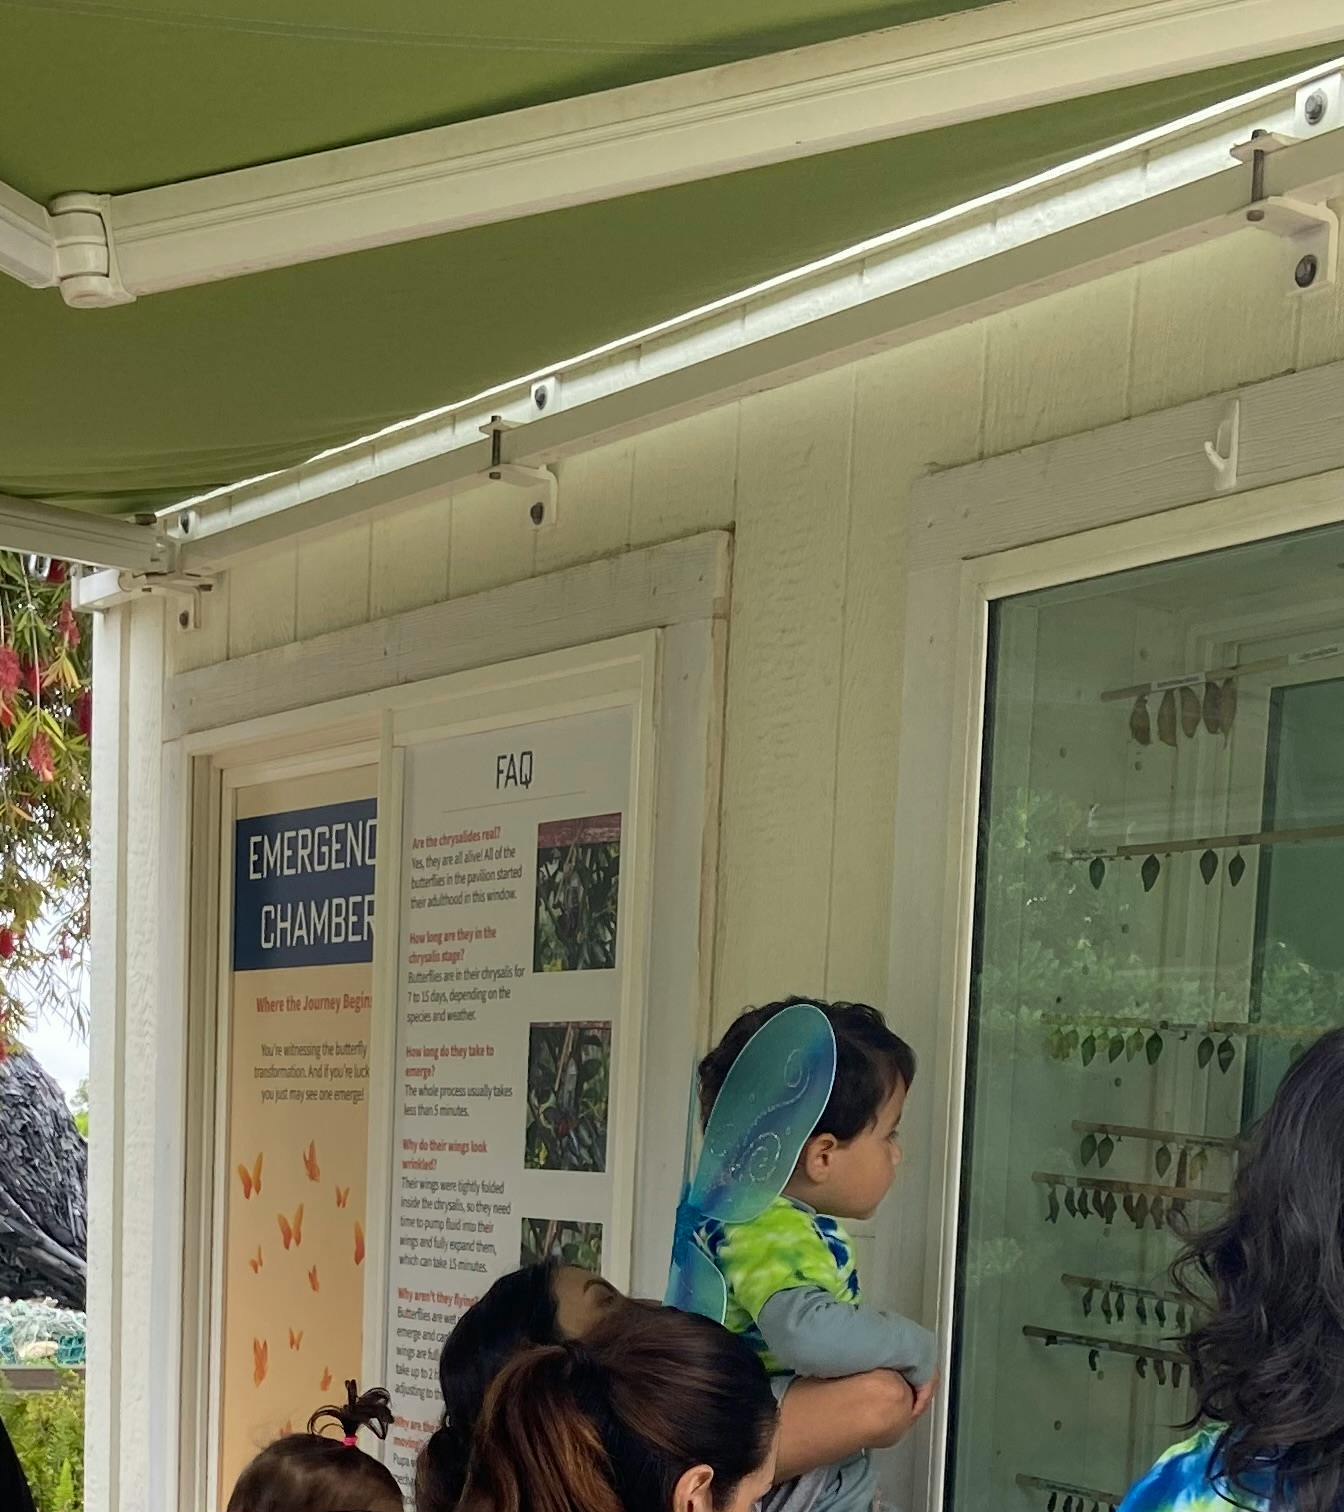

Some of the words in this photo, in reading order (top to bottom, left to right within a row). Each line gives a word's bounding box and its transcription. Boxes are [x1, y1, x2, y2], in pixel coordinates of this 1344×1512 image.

[497, 751, 533, 789] FAQ
[413, 837, 425, 849] Are
[426, 835, 438, 847] the
[439, 830, 481, 848] chrysalides
[482, 826, 501, 841] real?
[412, 857, 424, 869] Yes,
[426, 855, 441, 870] they
[442, 856, 453, 866] are
[455, 852, 463, 864] all
[464, 850, 483, 863] alive!
[484, 848, 494, 861] All
[495, 847, 503, 860] of
[504, 847, 516, 859] the
[411, 874, 445, 890] butterflies
[446, 875, 453, 886] in
[454, 874, 466, 885] the
[467, 869, 496, 887] pavilion
[497, 866, 523, 880] started
[411, 896, 427, 909] their
[427, 892, 463, 908] adulthood
[464, 892, 472, 904] in
[472, 890, 485, 903] this
[487, 888, 517, 901] window.
[261, 895, 375, 949] CHAMBER
[410, 932, 425, 944] How
[427, 931, 443, 946] long
[444, 933, 455, 941] are
[457, 928, 474, 943] they
[475, 927, 482, 940] in
[484, 926, 496, 939] the
[408, 950, 440, 966] chrysalis
[442, 948, 464, 965] stage?
[408, 970, 442, 984] Butterflies
[444, 972, 454, 982] are
[456, 969, 463, 981] in
[464, 968, 480, 981] their
[481, 966, 513, 982] chrysalis
[515, 964, 526, 978] for
[408, 992, 412, 1002] 7
[413, 992, 421, 1003] to
[422, 991, 430, 1003] 15
[450, 987, 487, 1004] depending
[488, 990, 498, 1000] on
[499, 986, 511, 999] the
[257, 996, 284, 1012] Where
[287, 996, 301, 1011] the
[304, 996, 341, 1013] Journey
[407, 1011, 432, 1024] species
[433, 1010, 446, 1022] and
[447, 1009, 476, 1021] weather.
[262, 1044, 282, 1056] You're
[284, 1042, 321, 1059] witnessing
[323, 1042, 334, 1056] the
[336, 1040, 367, 1059] butterfly
[406, 1047, 422, 1058] How
[423, 1045, 439, 1061] long
[440, 1045, 449, 1056] do
[451, 1045, 467, 1059] they
[469, 1044, 485, 1056] take
[486, 1045, 495, 1056] to
[255, 1065, 307, 1078] transformation.
[309, 1065, 323, 1078] And
[324, 1064, 329, 1078] if
[330, 1065, 352, 1080] you're
[406, 1065, 436, 1080] emerge?
[261, 1090, 274, 1103] you
[275, 1088, 288, 1103] just
[290, 1090, 305, 1102] may
[306, 1090, 317, 1100] see
[320, 1090, 333, 1100] one
[334, 1088, 364, 1104] emerge!
[405, 1084, 417, 1096] The
[419, 1084, 439, 1097] whole
[440, 1087, 466, 1099] process
[467, 1084, 492, 1100] usually
[494, 1084, 513, 1097] takes
[404, 1104, 417, 1116] less
[418, 1104, 433, 1117] than
[434, 1105, 439, 1116] 5
[440, 1105, 469, 1117] minutes.
[403, 1139, 417, 1154] Why
[419, 1139, 429, 1151] do
[430, 1139, 447, 1152] their
[448, 1141, 469, 1156] wings
[471, 1141, 488, 1153] look
[402, 1177, 418, 1189] Their
[420, 1180, 439, 1194] wings
[441, 1182, 457, 1192] were
[458, 1180, 480, 1196] tightly
[482, 1180, 504, 1194] folded
[401, 1197, 420, 1208] inside
[422, 1198, 432, 1209] the
[434, 1198, 465, 1213] chrysalis,
[467, 1202, 475, 1213] so
[476, 1201, 492, 1217] they
[493, 1202, 511, 1215] need
[400, 1256, 418, 1266] which
[420, 1258, 433, 1268] can
[433, 1257, 447, 1269] take
[449, 1258, 457, 1270] 15
[458, 1260, 488, 1273] minutes.
